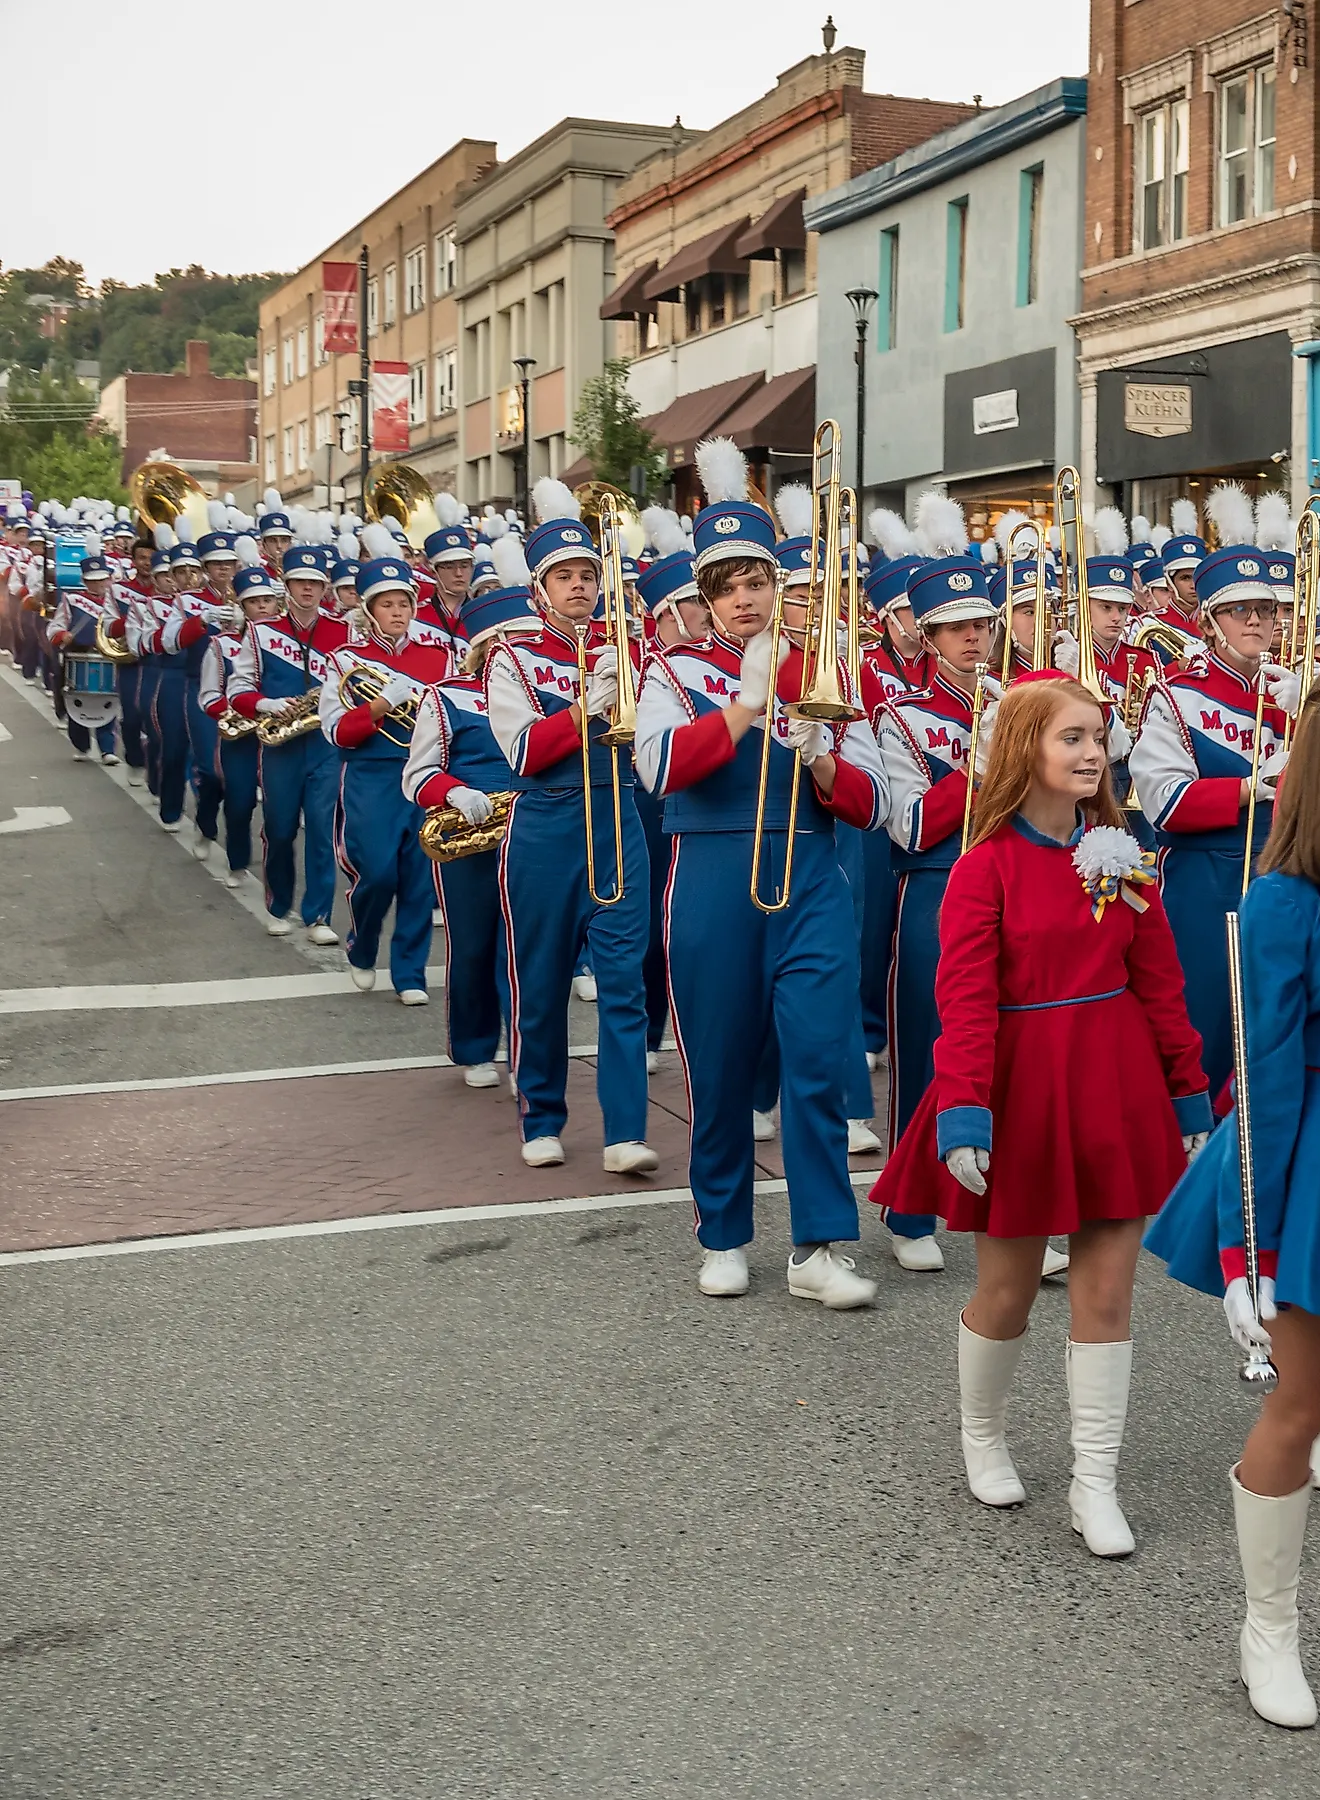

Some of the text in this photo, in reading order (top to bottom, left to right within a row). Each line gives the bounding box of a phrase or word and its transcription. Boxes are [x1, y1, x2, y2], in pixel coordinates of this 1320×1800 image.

[1128, 387, 1188, 402] SPENCER
[269, 637, 328, 682] MOHGA
[1200, 699, 1275, 761] MOHG
